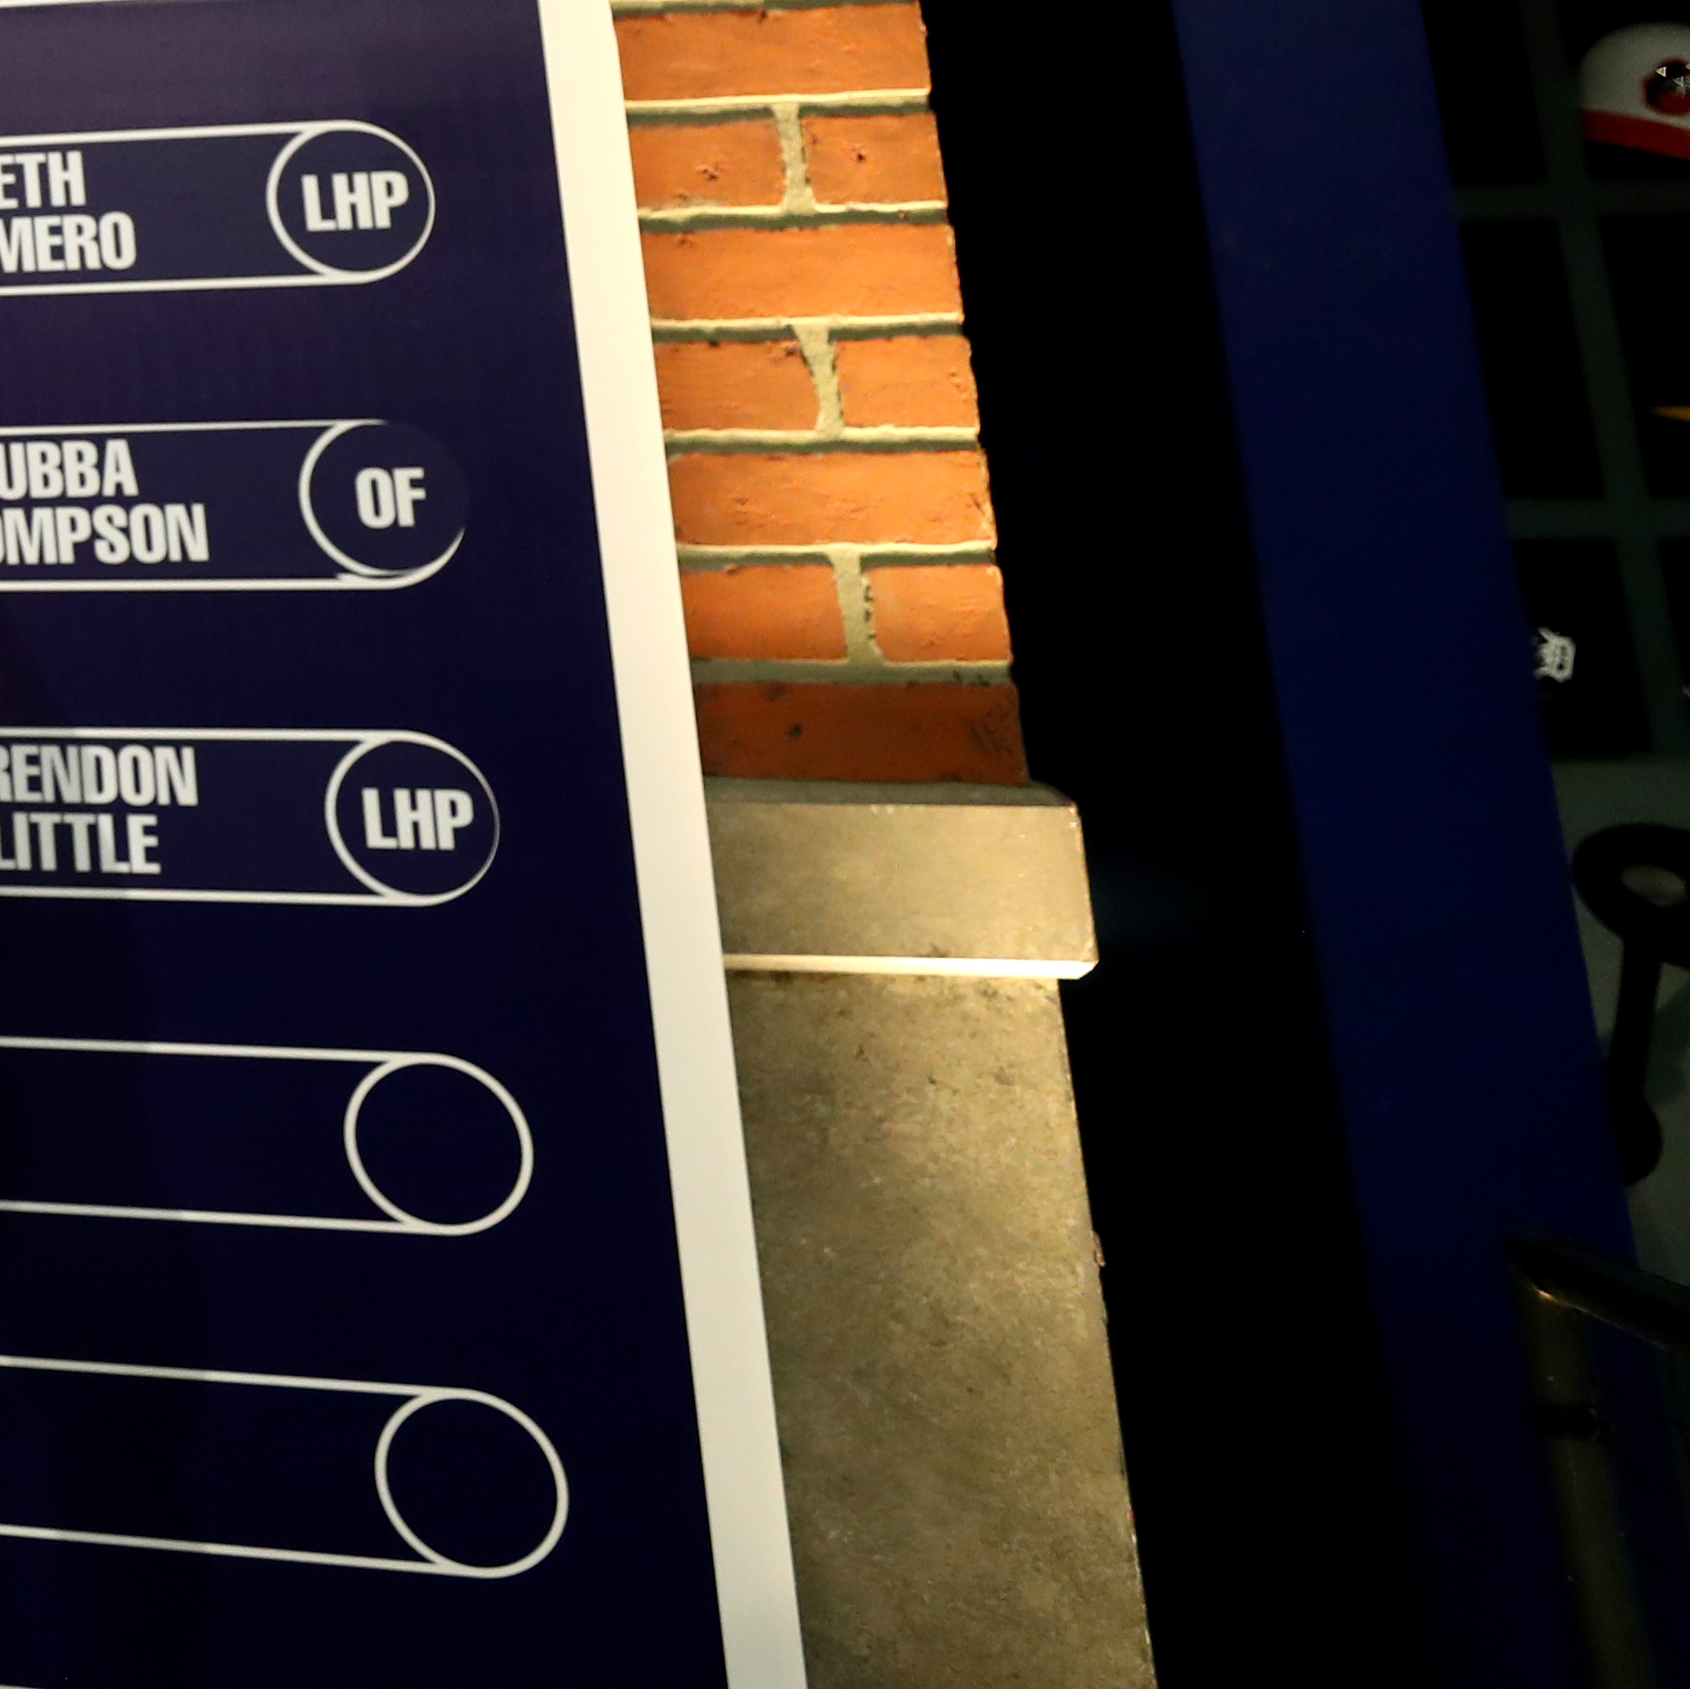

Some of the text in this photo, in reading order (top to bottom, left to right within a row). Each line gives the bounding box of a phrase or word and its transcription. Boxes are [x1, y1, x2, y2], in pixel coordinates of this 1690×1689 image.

[301, 171, 409, 232] LHP
[355, 467, 426, 529] OF
[362, 787, 474, 851] LHP
